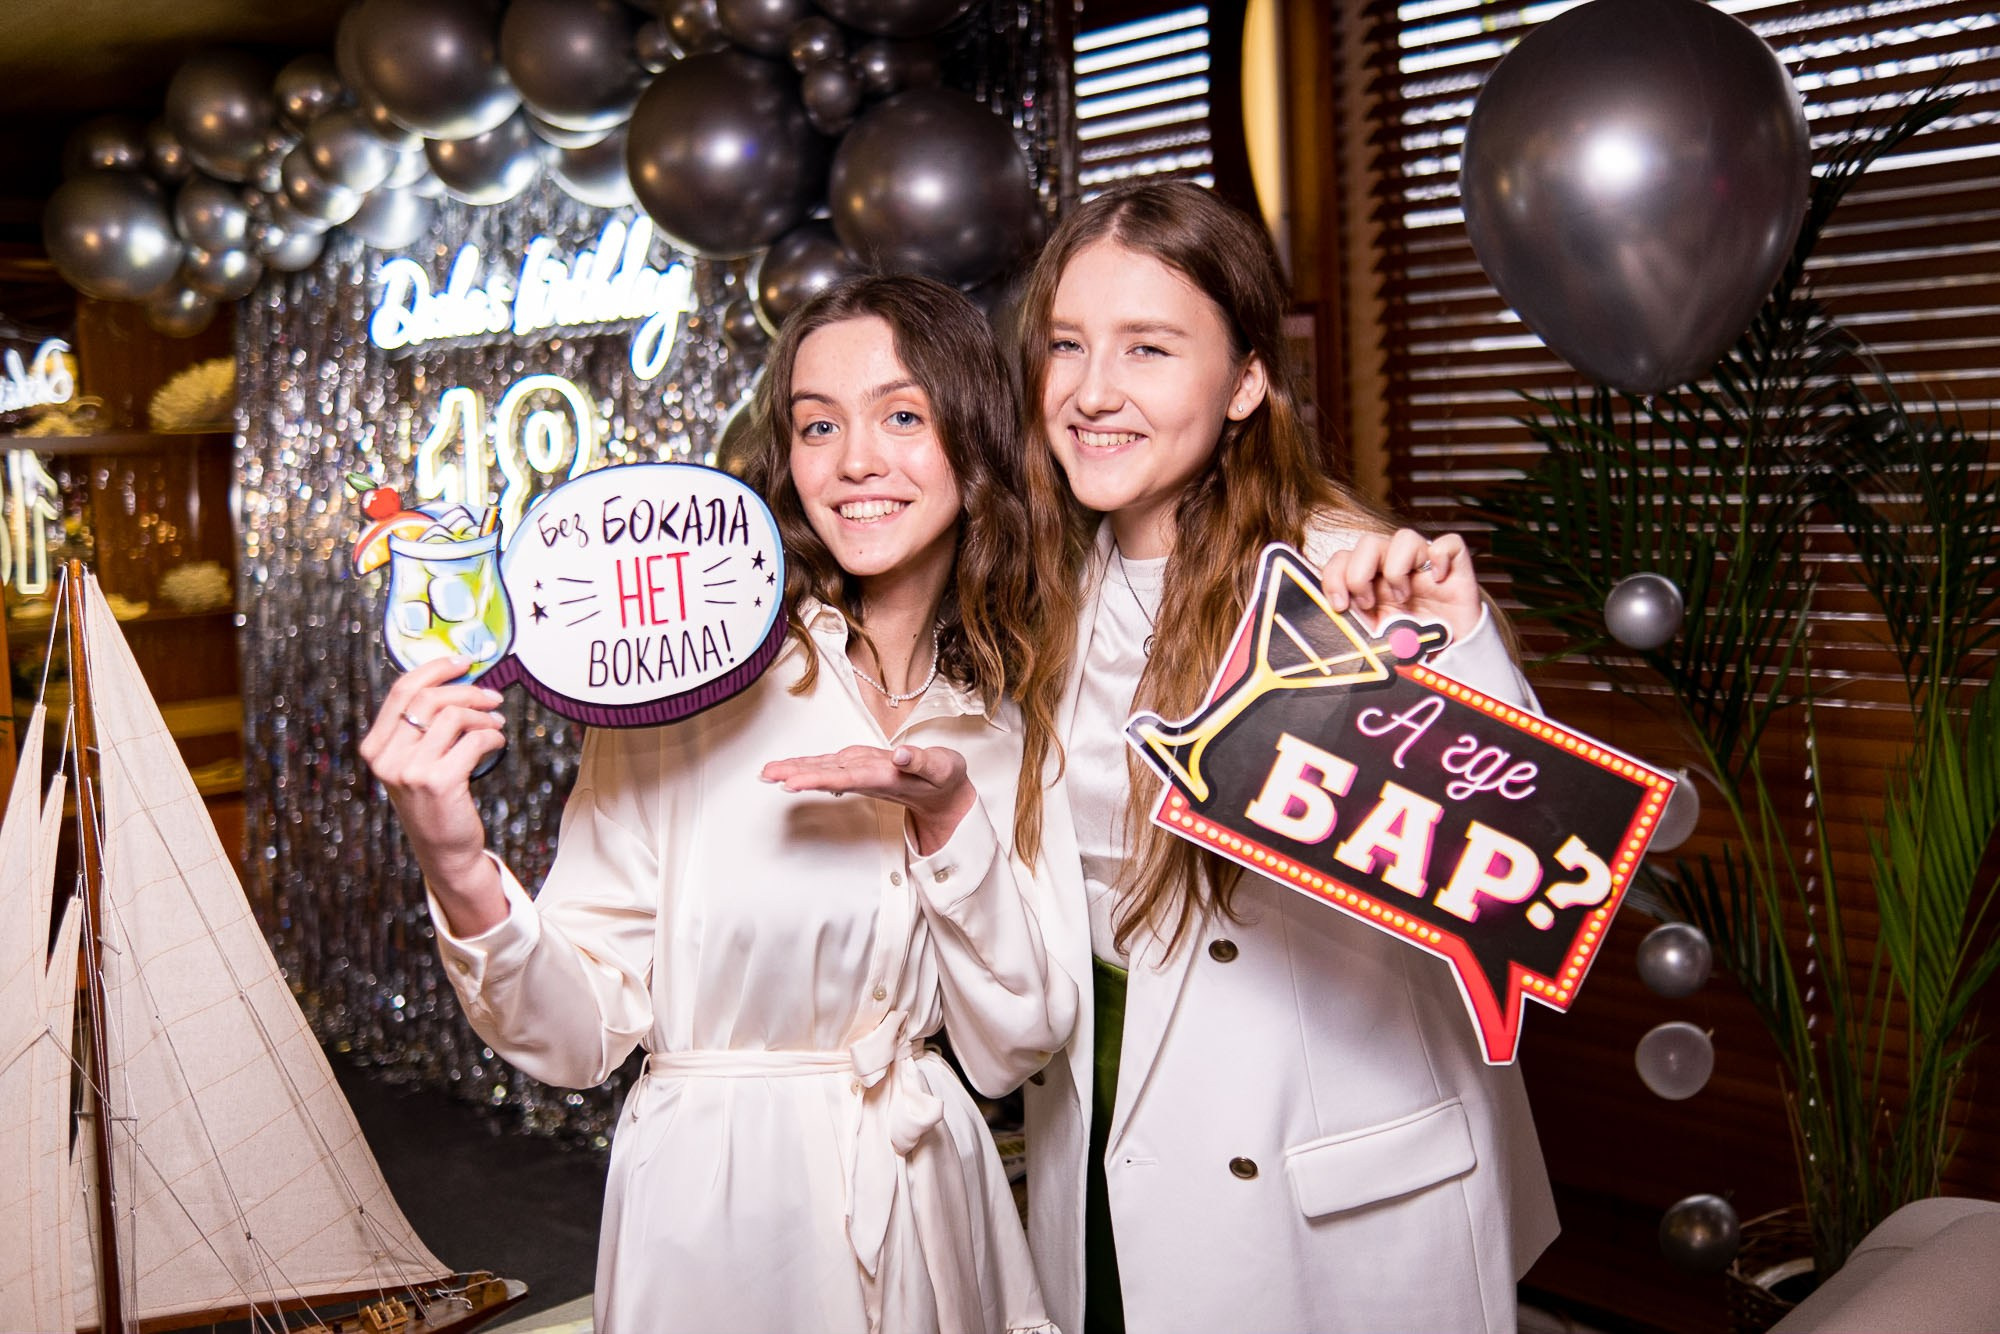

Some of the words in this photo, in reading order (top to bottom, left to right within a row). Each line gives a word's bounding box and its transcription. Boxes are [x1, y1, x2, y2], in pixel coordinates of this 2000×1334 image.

[537, 512, 589, 548] Без
[603, 494, 749, 546] БОКАЛА
[616, 551, 690, 628] НЕТ
[588, 619, 736, 688] ВОКАЛА!
[1356, 695, 1446, 770] А
[1441, 734, 1537, 801] где
[1244, 732, 1613, 932] БАР?
